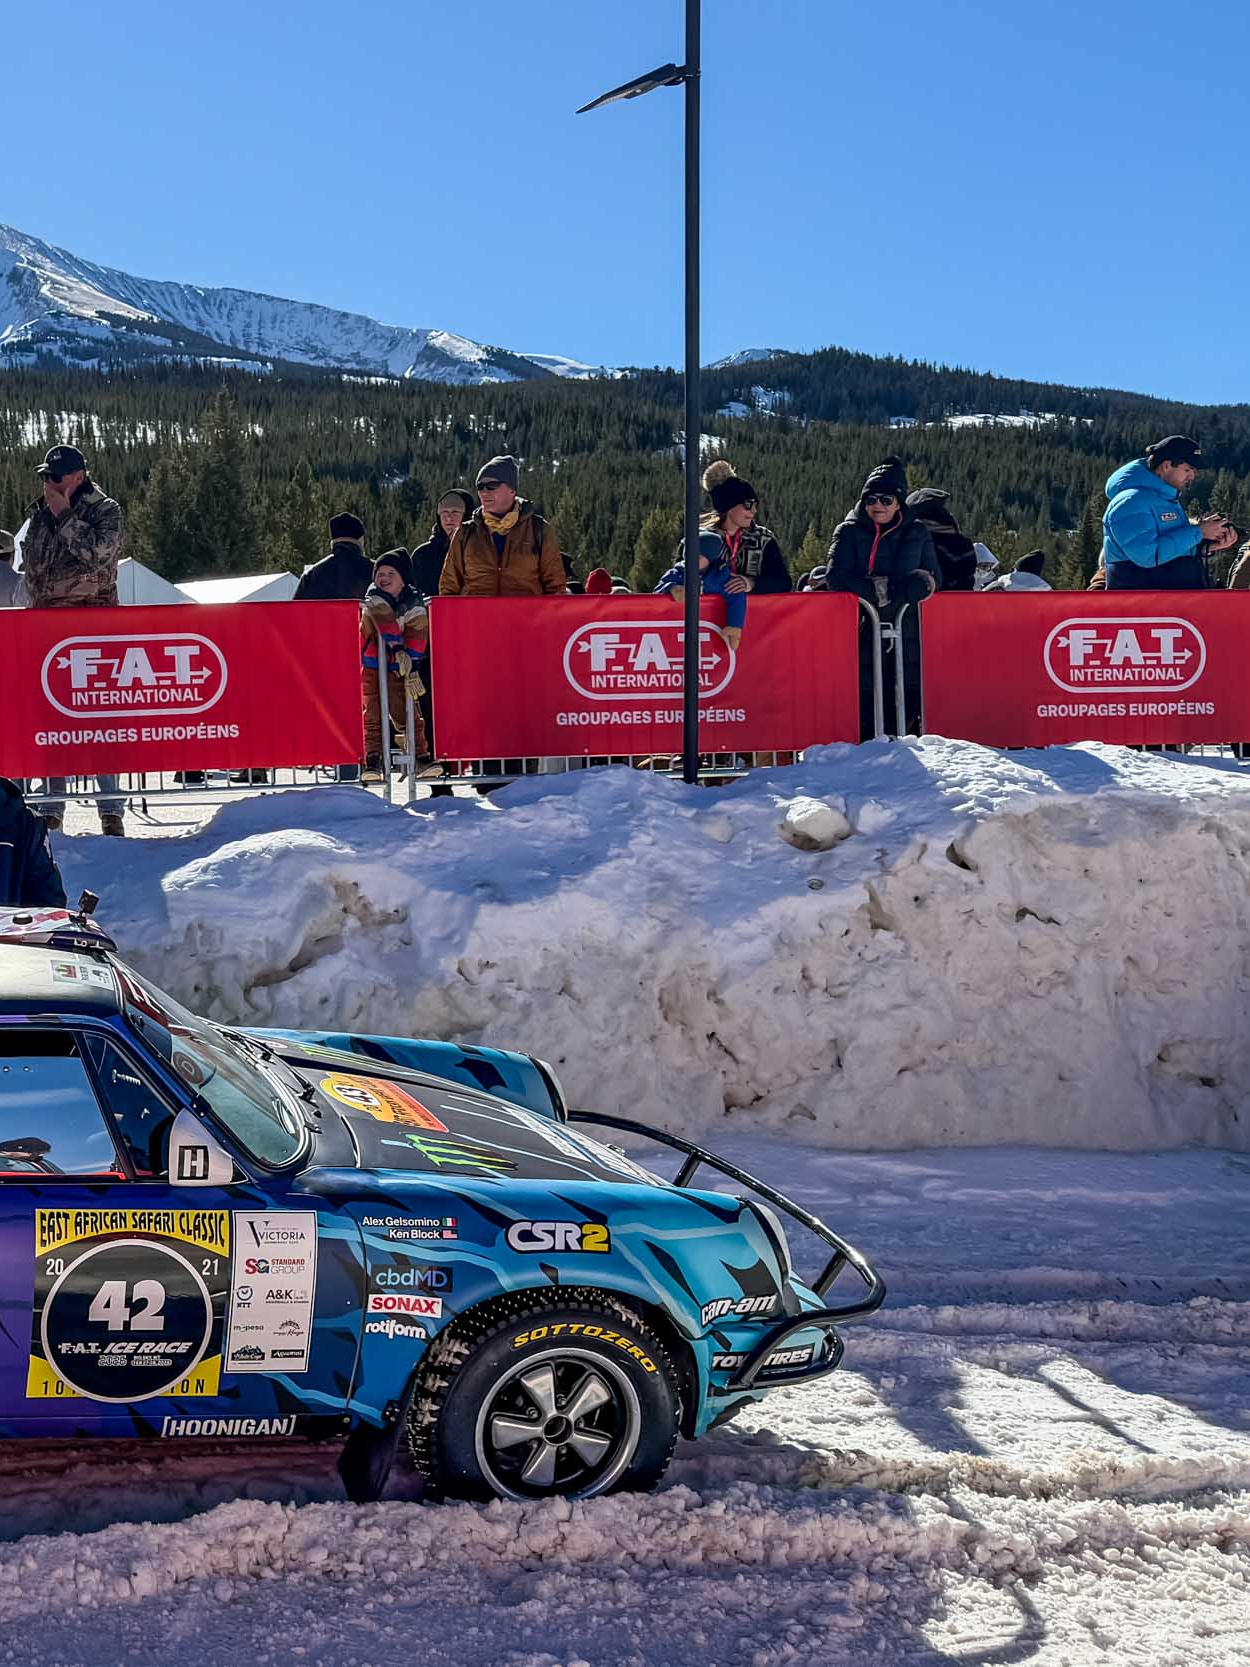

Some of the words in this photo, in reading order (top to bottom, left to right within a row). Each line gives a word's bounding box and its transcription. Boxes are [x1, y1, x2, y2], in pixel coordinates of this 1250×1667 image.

[591, 673, 713, 689] INTERNATIOAL
[1070, 667, 1184, 682] INTERNATIONAL
[71, 687, 204, 706] INTERNATIONAL
[556, 709, 651, 726] GROUPAGES
[654, 706, 746, 725] EURPÉENS
[1037, 702, 1126, 718] GROUPAGES
[1129, 699, 1215, 717] EUROPÉENS
[34, 727, 138, 746] GROUPAGES
[141, 721, 240, 742] EUROPÉENS
[40, 1211, 70, 1248] EAST
[75, 1211, 127, 1236] AFRICAN
[132, 1211, 175, 1233] SAFARI
[179, 1212, 226, 1248] CLASSIC
[362, 1216, 384, 1226] Alex
[385, 1216, 440, 1226] Gelsomino
[259, 1231, 306, 1241] VICTORIA
[389, 1229, 410, 1239] Ken
[411, 1229, 440, 1239] Block
[508, 1222, 610, 1252] CSR2
[46, 1259, 64, 1276] 20
[202, 1259, 219, 1276] 21
[271, 1266, 305, 1275] GROUP
[375, 1268, 448, 1287] cbdMD
[266, 1289, 293, 1300] A&K
[88, 1279, 166, 1331] 42
[371, 1297, 437, 1315] SONAX
[701, 1294, 778, 1327] can-am
[365, 1320, 426, 1339] rotiform
[103, 1342, 140, 1354] ICE
[137, 1342, 193, 1354] RACE
[512, 1323, 659, 1374] SOTTOZERO
[712, 1353, 747, 1367] TOY
